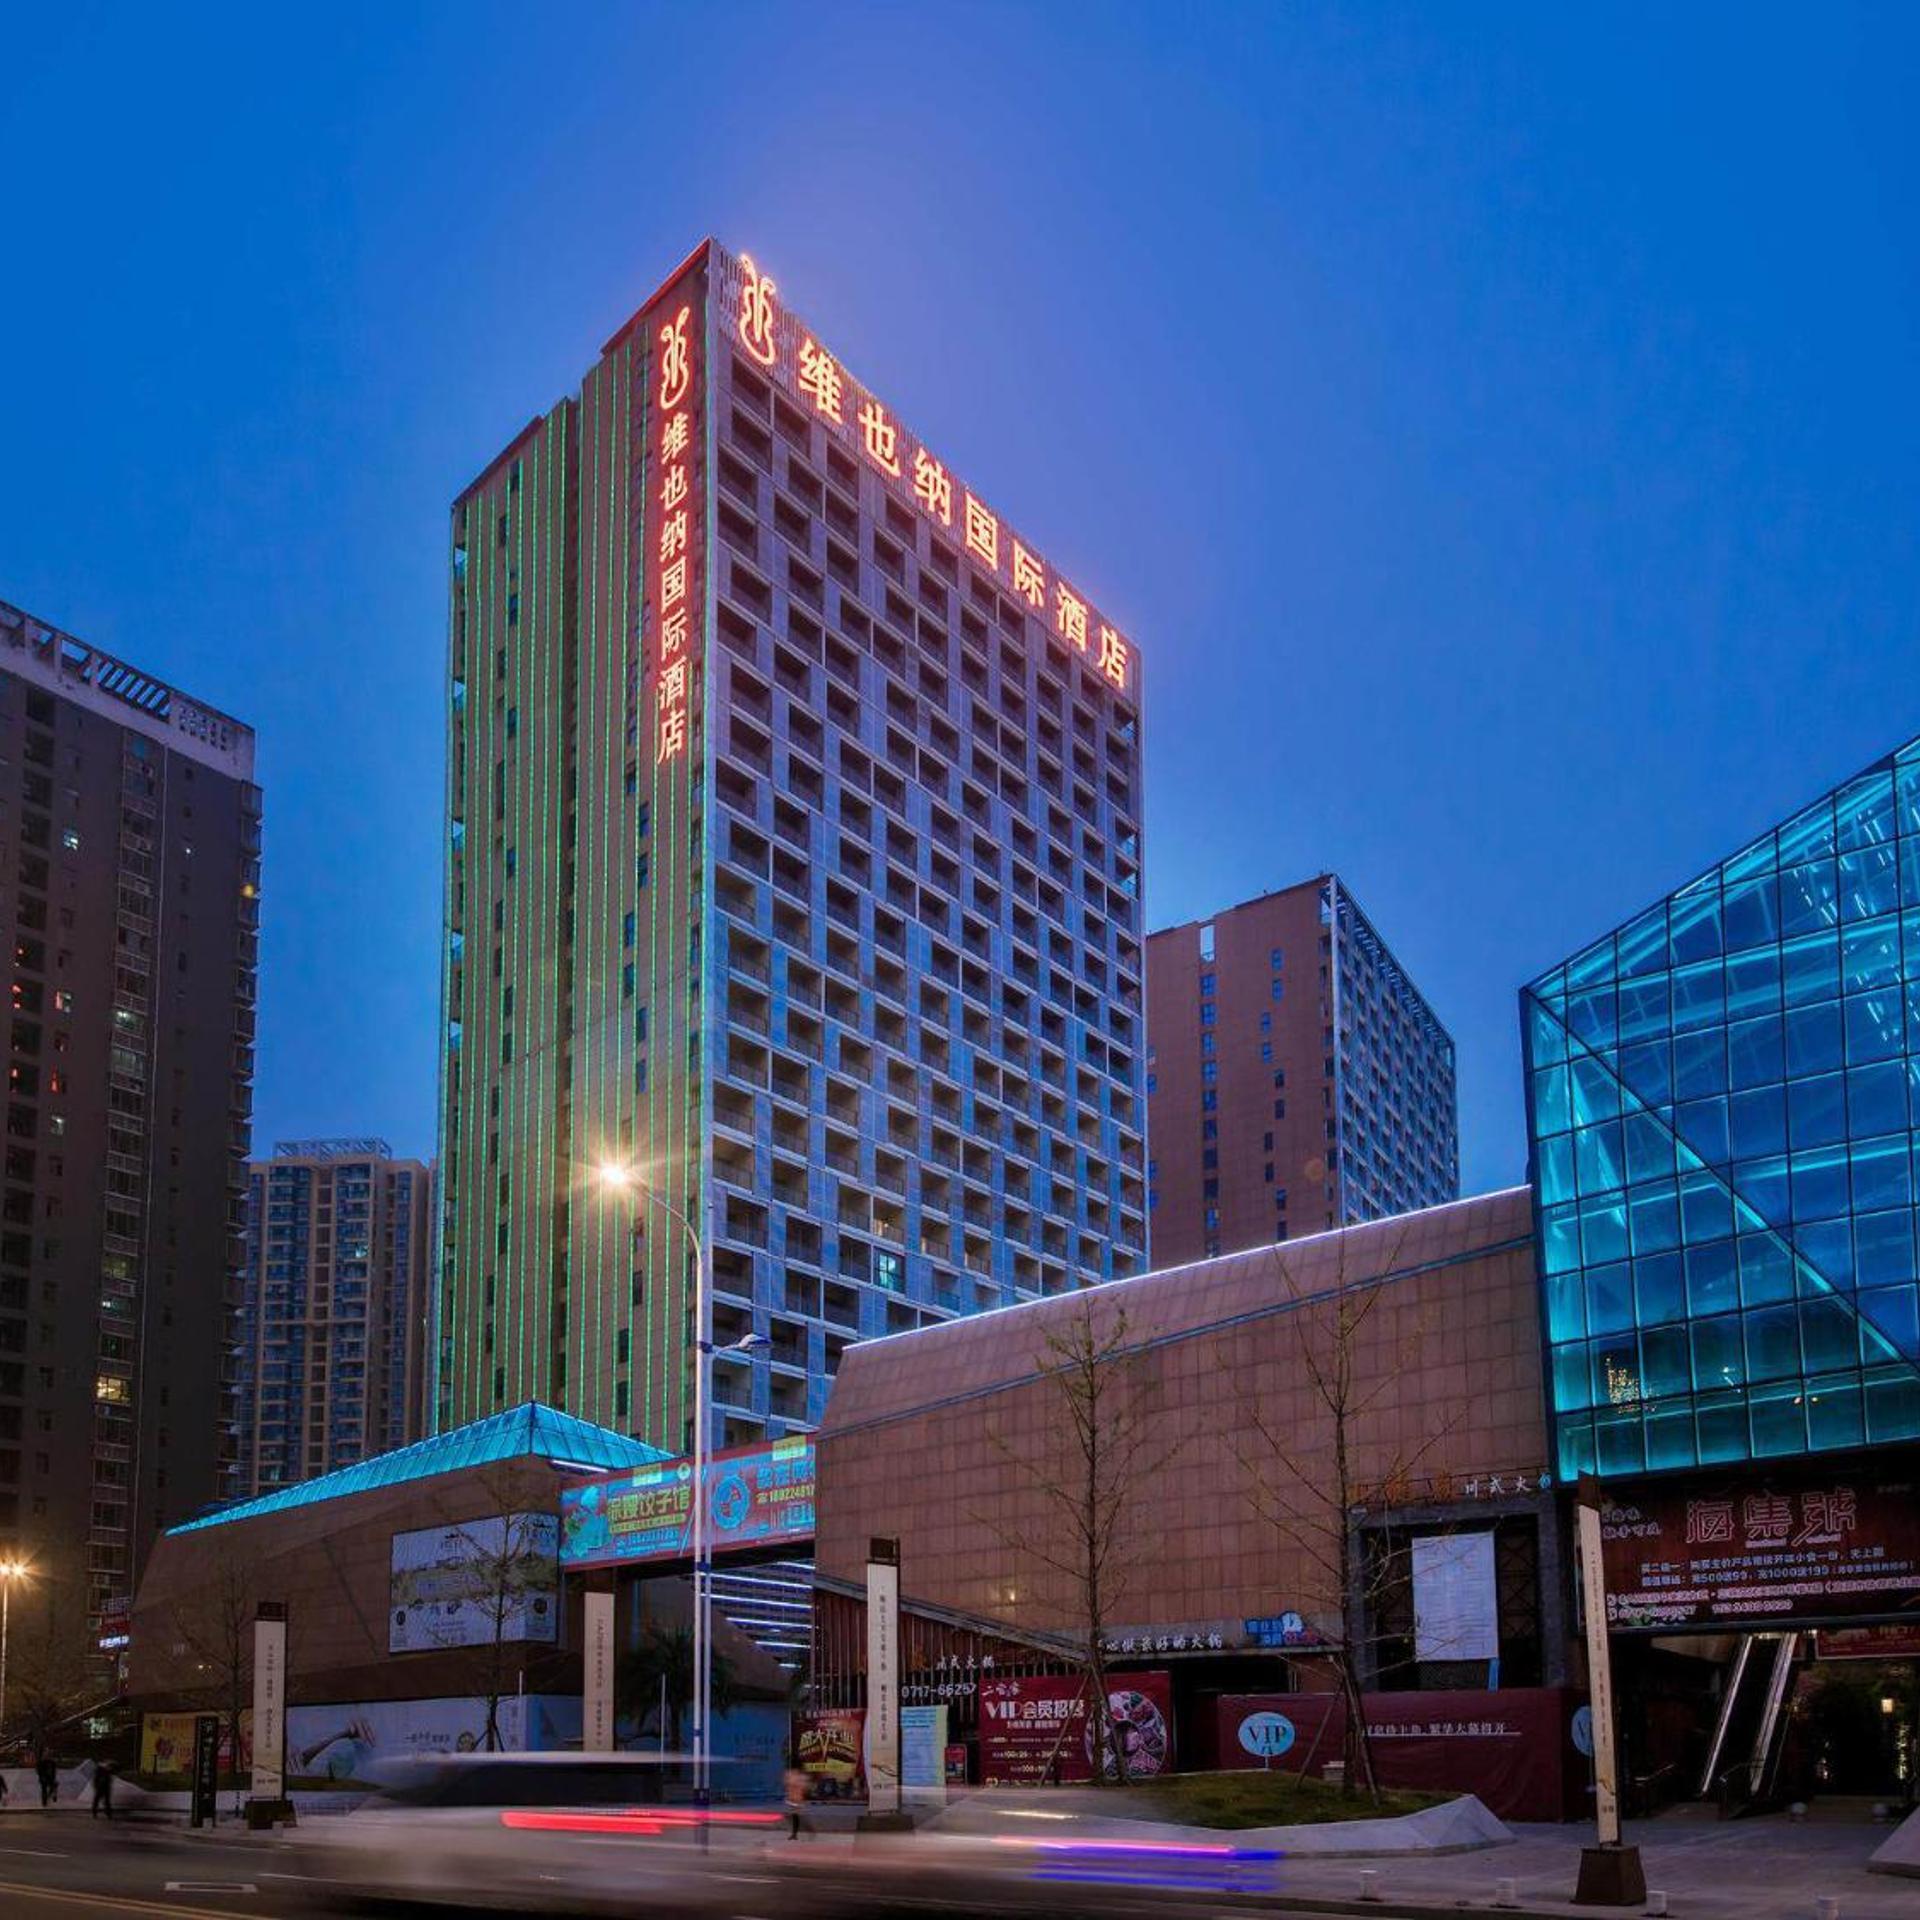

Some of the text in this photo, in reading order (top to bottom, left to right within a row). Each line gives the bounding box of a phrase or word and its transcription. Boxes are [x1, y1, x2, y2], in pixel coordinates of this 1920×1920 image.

[658, 411, 689, 765] 维也纳国际酒店
[797, 336, 1129, 688] 维也纳国际酒店
[1097, 1632, 1223, 1653] 心做最好的火锅
[1248, 1725, 1287, 1743] VIP
